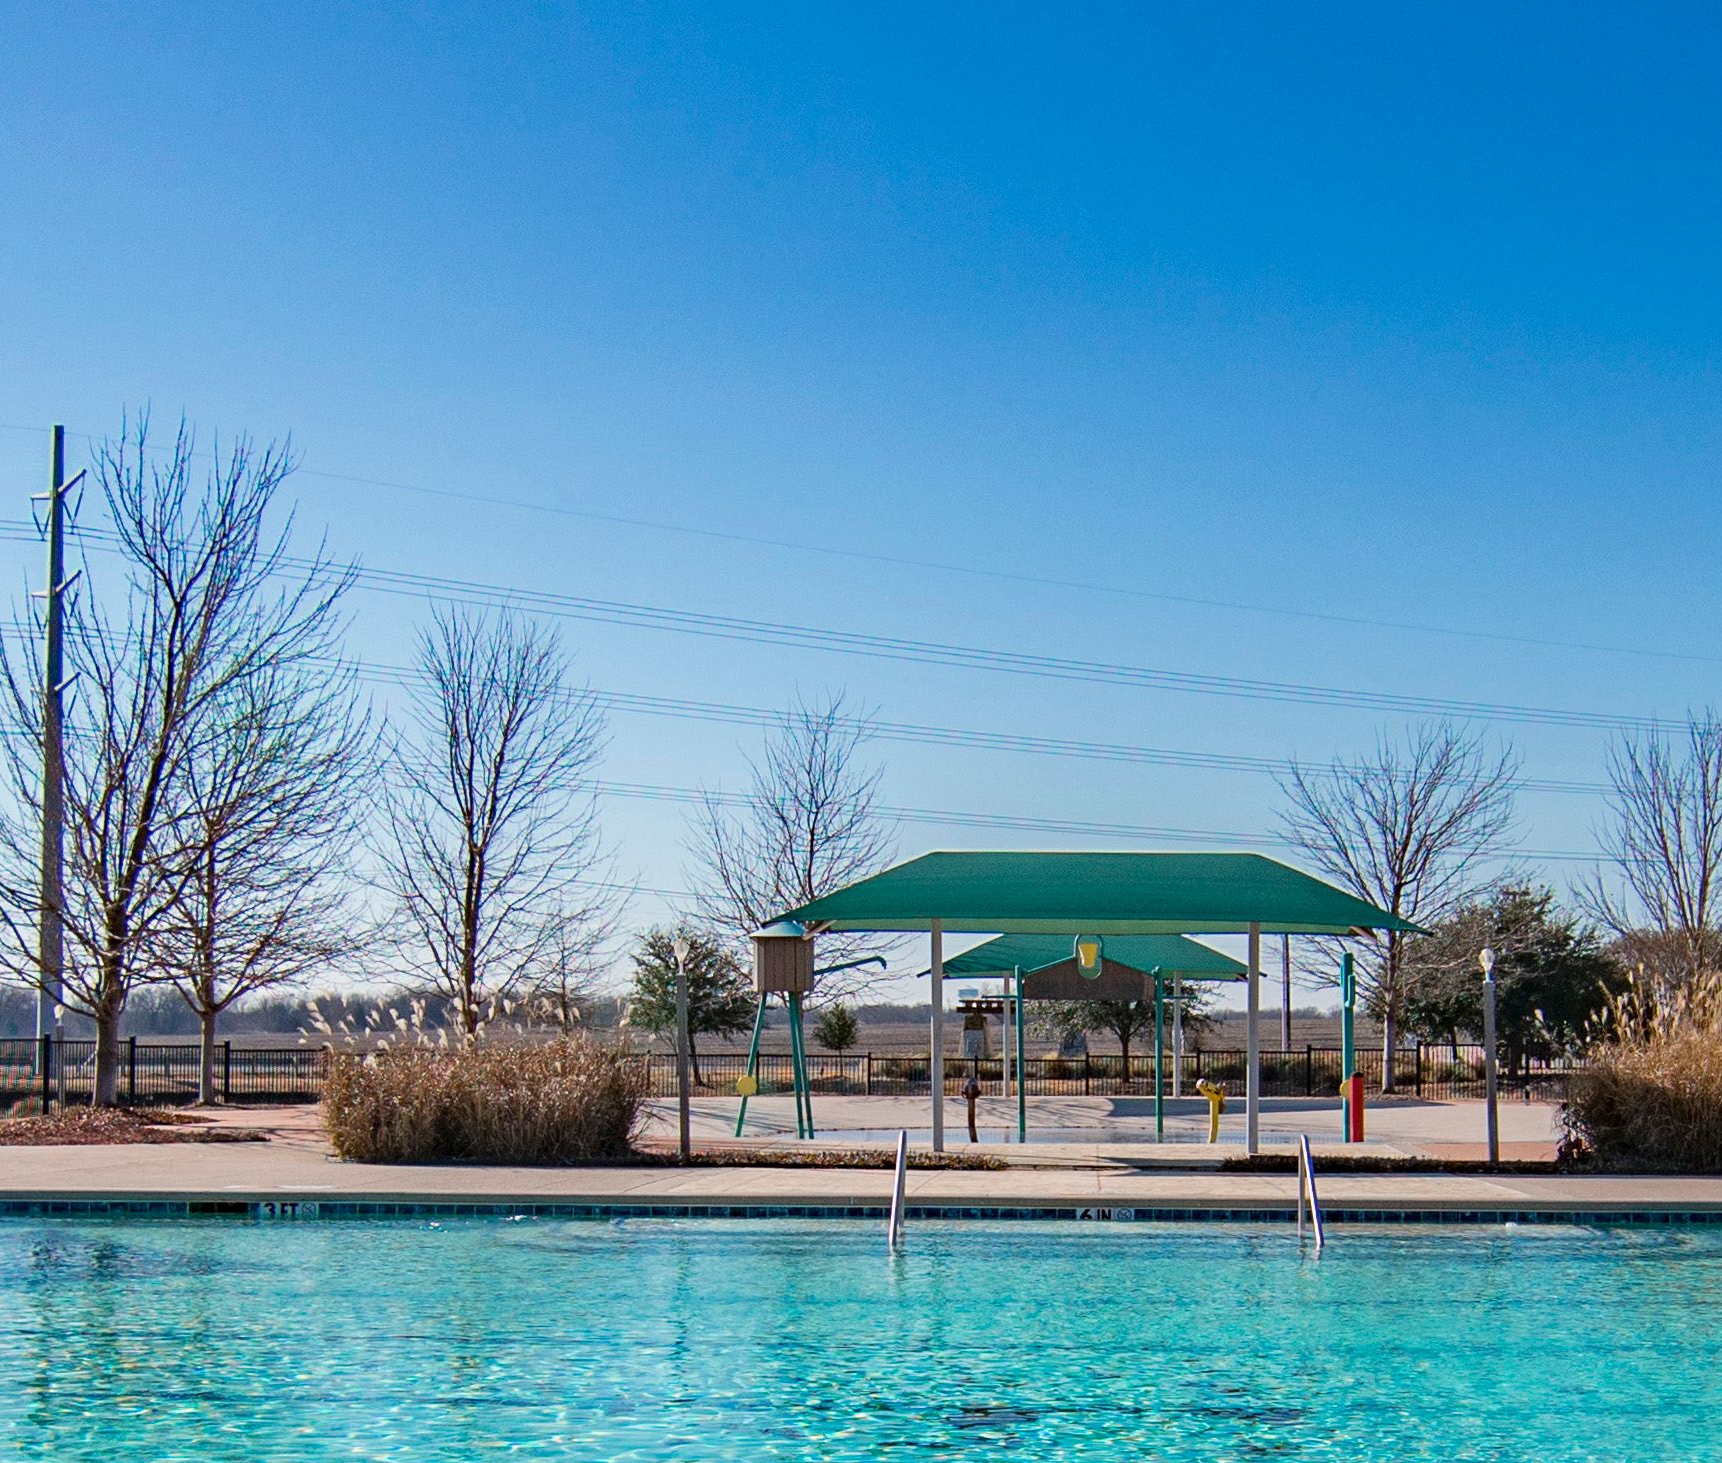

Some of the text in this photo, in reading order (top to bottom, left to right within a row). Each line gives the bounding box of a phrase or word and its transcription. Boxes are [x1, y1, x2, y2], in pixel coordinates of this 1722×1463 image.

[280, 1203, 298, 1219] FT
[1079, 1208, 1112, 1220] 6 IN
